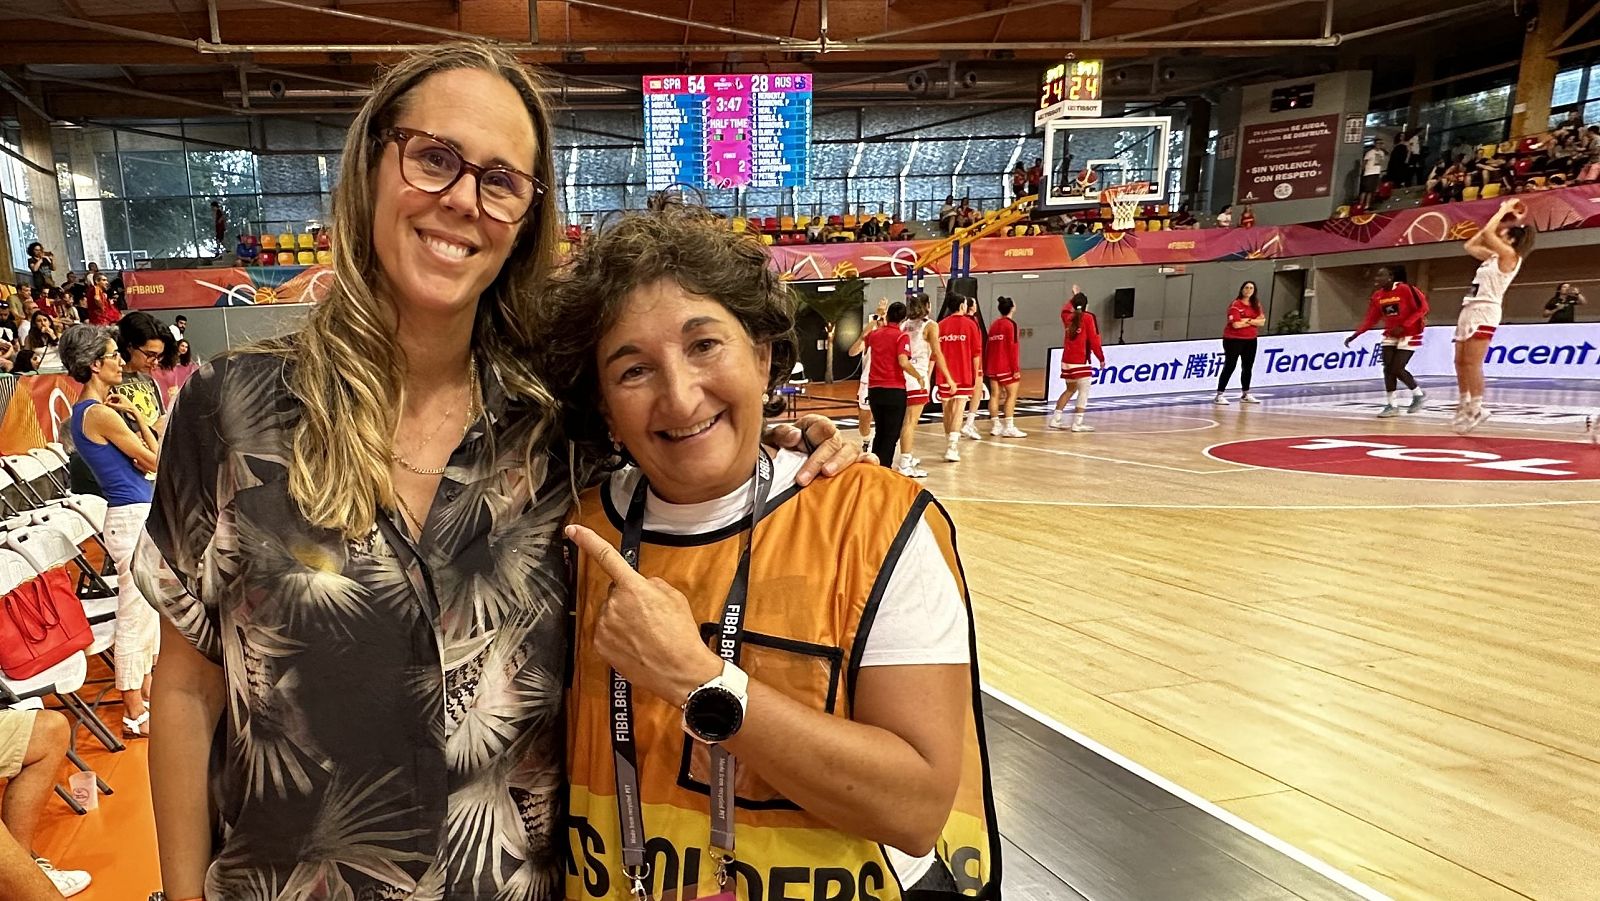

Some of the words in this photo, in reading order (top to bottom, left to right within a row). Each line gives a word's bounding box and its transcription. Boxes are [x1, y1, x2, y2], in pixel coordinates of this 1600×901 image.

[663, 78, 681, 90] SPA
[688, 75, 705, 94] 54
[751, 75, 769, 93] 28
[774, 77, 792, 88] AUS
[1069, 76, 1098, 100] 24
[1041, 80, 1063, 109] 24
[716, 97, 743, 112] 3:47
[710, 118, 729, 129] HALF
[730, 118, 749, 129] TIME
[1302, 122, 1327, 130] JUEGA,
[715, 160, 721, 174] 1
[738, 160, 746, 173] 2
[1251, 166, 1267, 174] SIN
[1269, 160, 1321, 171] VIOLENCIA,
[1253, 175, 1273, 183] CON
[1274, 170, 1317, 180] RESPETO
[127, 284, 165, 295] #FIBAU19
[1263, 347, 1369, 374] Tencent
[1484, 341, 1597, 365] ncent
[1091, 358, 1183, 385] encent
[1288, 437, 1579, 477] TCL
